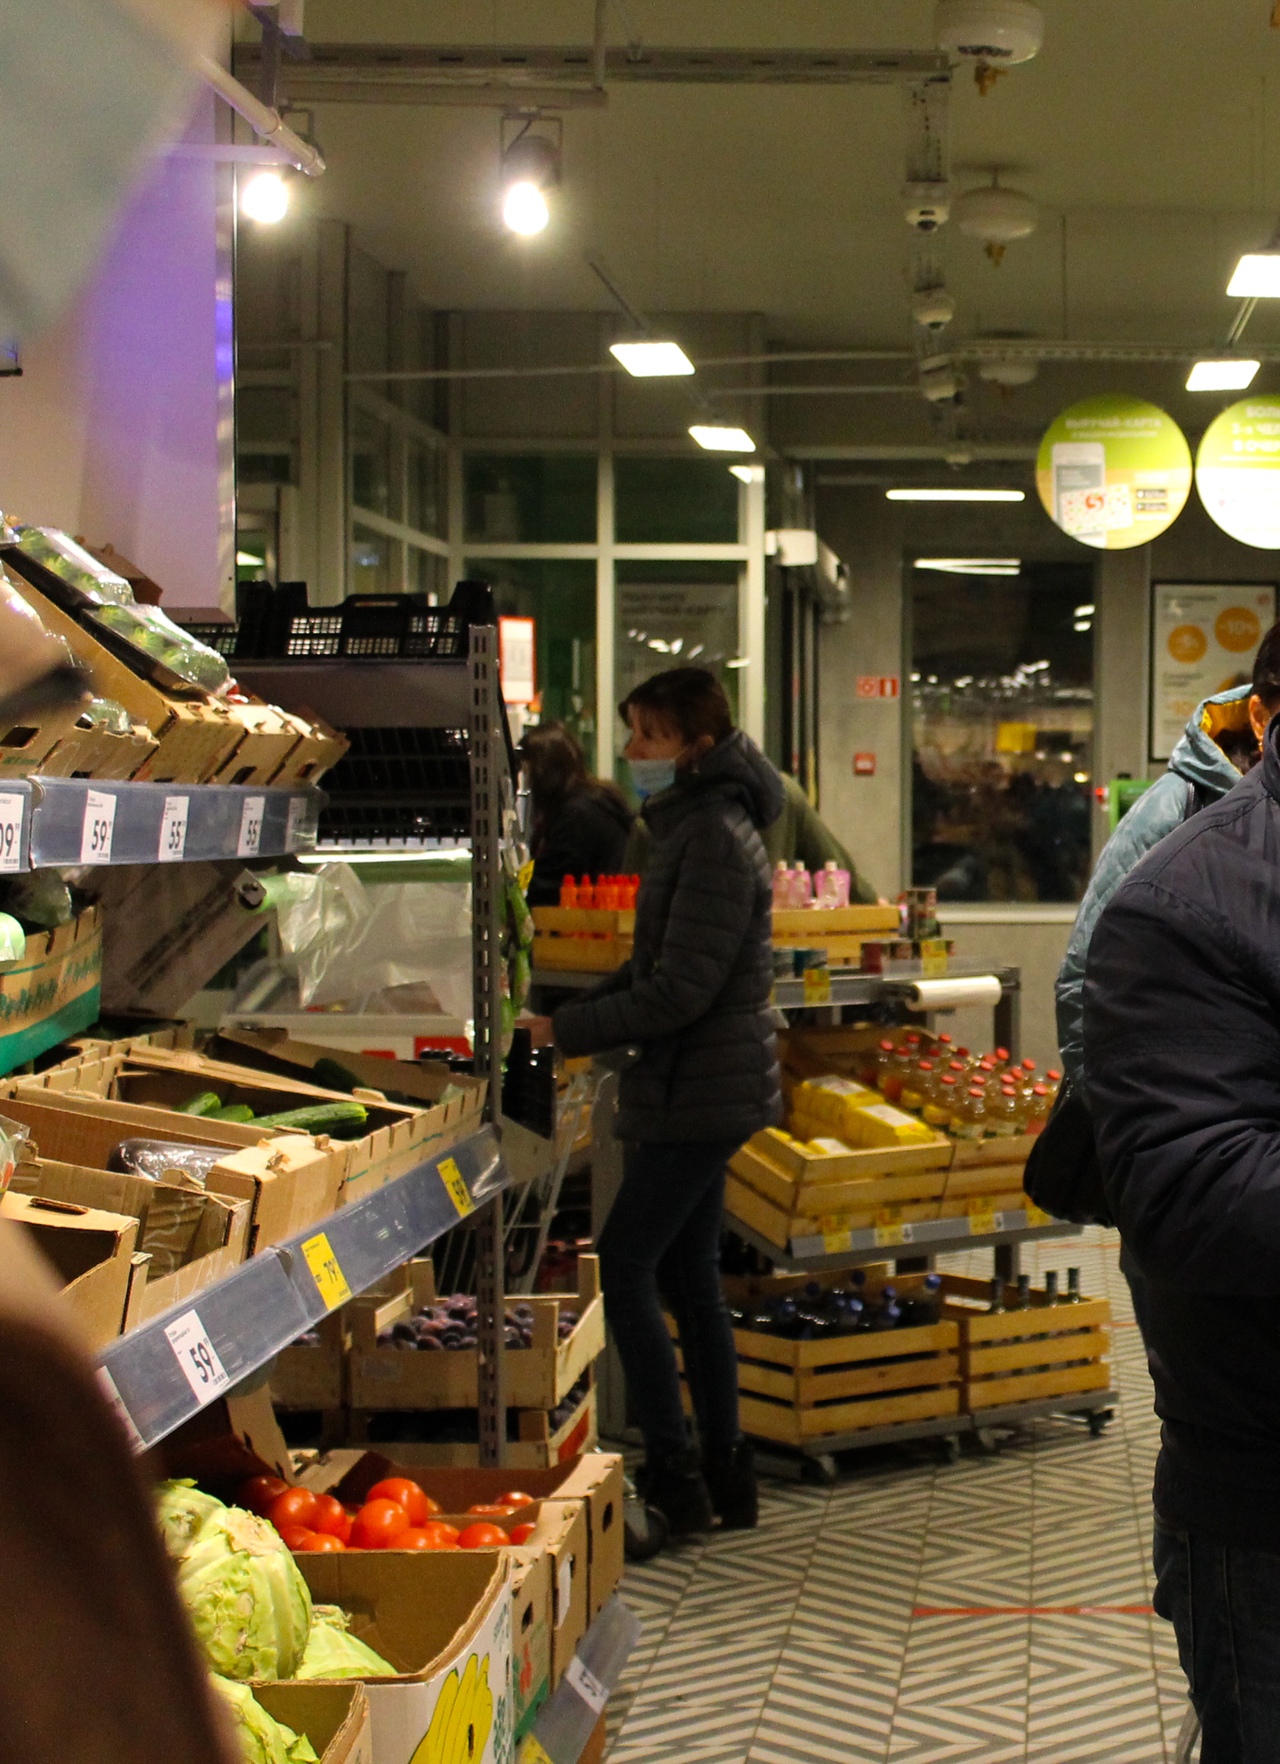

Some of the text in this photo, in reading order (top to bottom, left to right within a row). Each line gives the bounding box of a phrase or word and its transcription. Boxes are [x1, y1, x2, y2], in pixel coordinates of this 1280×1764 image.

[91, 819, 108, 851] 59
[168, 821, 182, 850] 55
[246, 820, 258, 847] 55
[323, 1260, 338, 1284] 79
[189, 1341, 215, 1384] 59
